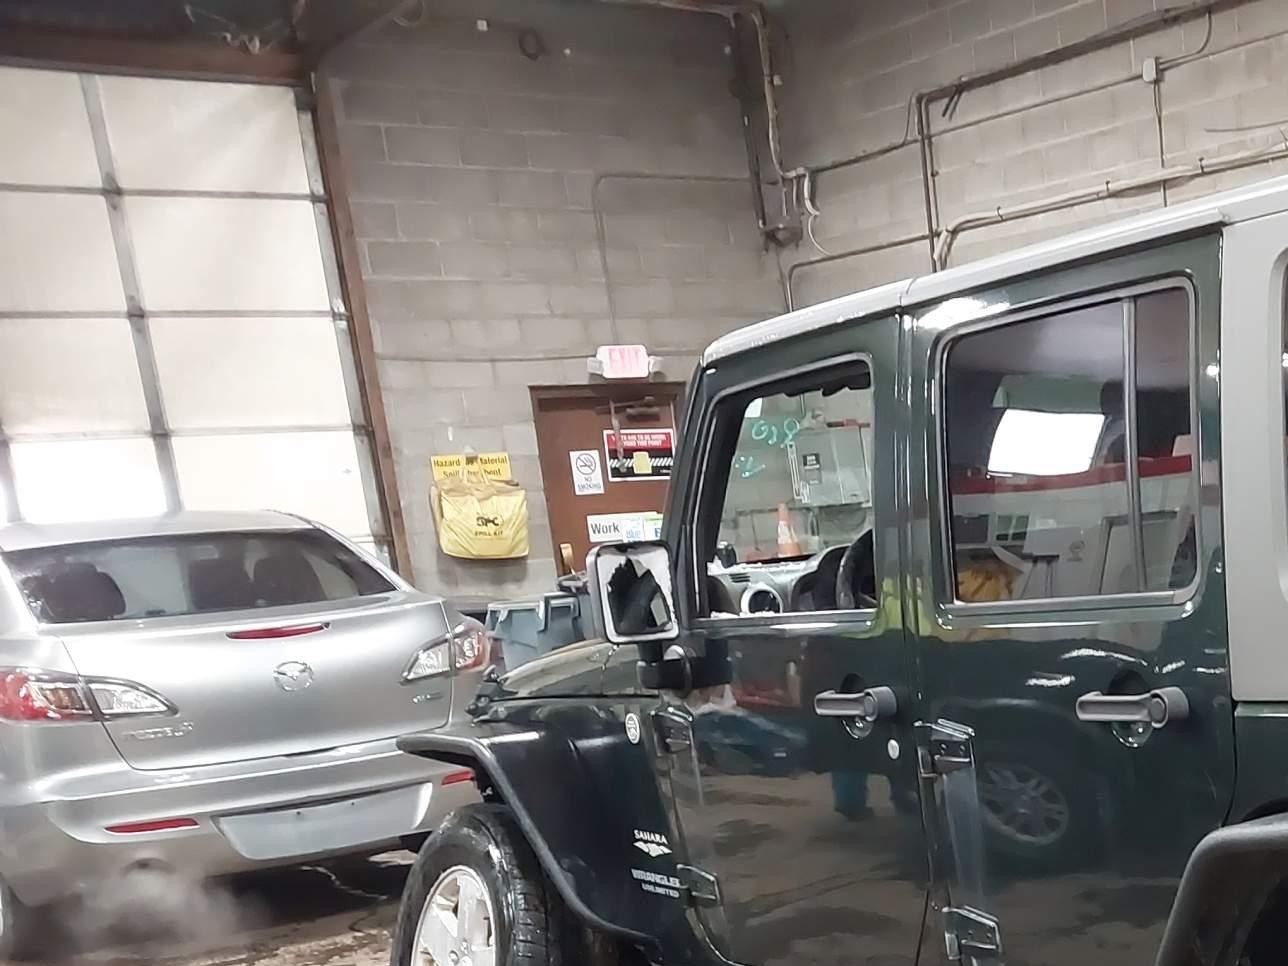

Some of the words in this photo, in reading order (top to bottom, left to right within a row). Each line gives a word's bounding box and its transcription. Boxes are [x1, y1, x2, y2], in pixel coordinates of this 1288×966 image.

[607, 347, 642, 369] EXIT
[590, 522, 620, 535] Work
[633, 829, 669, 845] SAHARA
[641, 882, 680, 899] UNLIMITED
